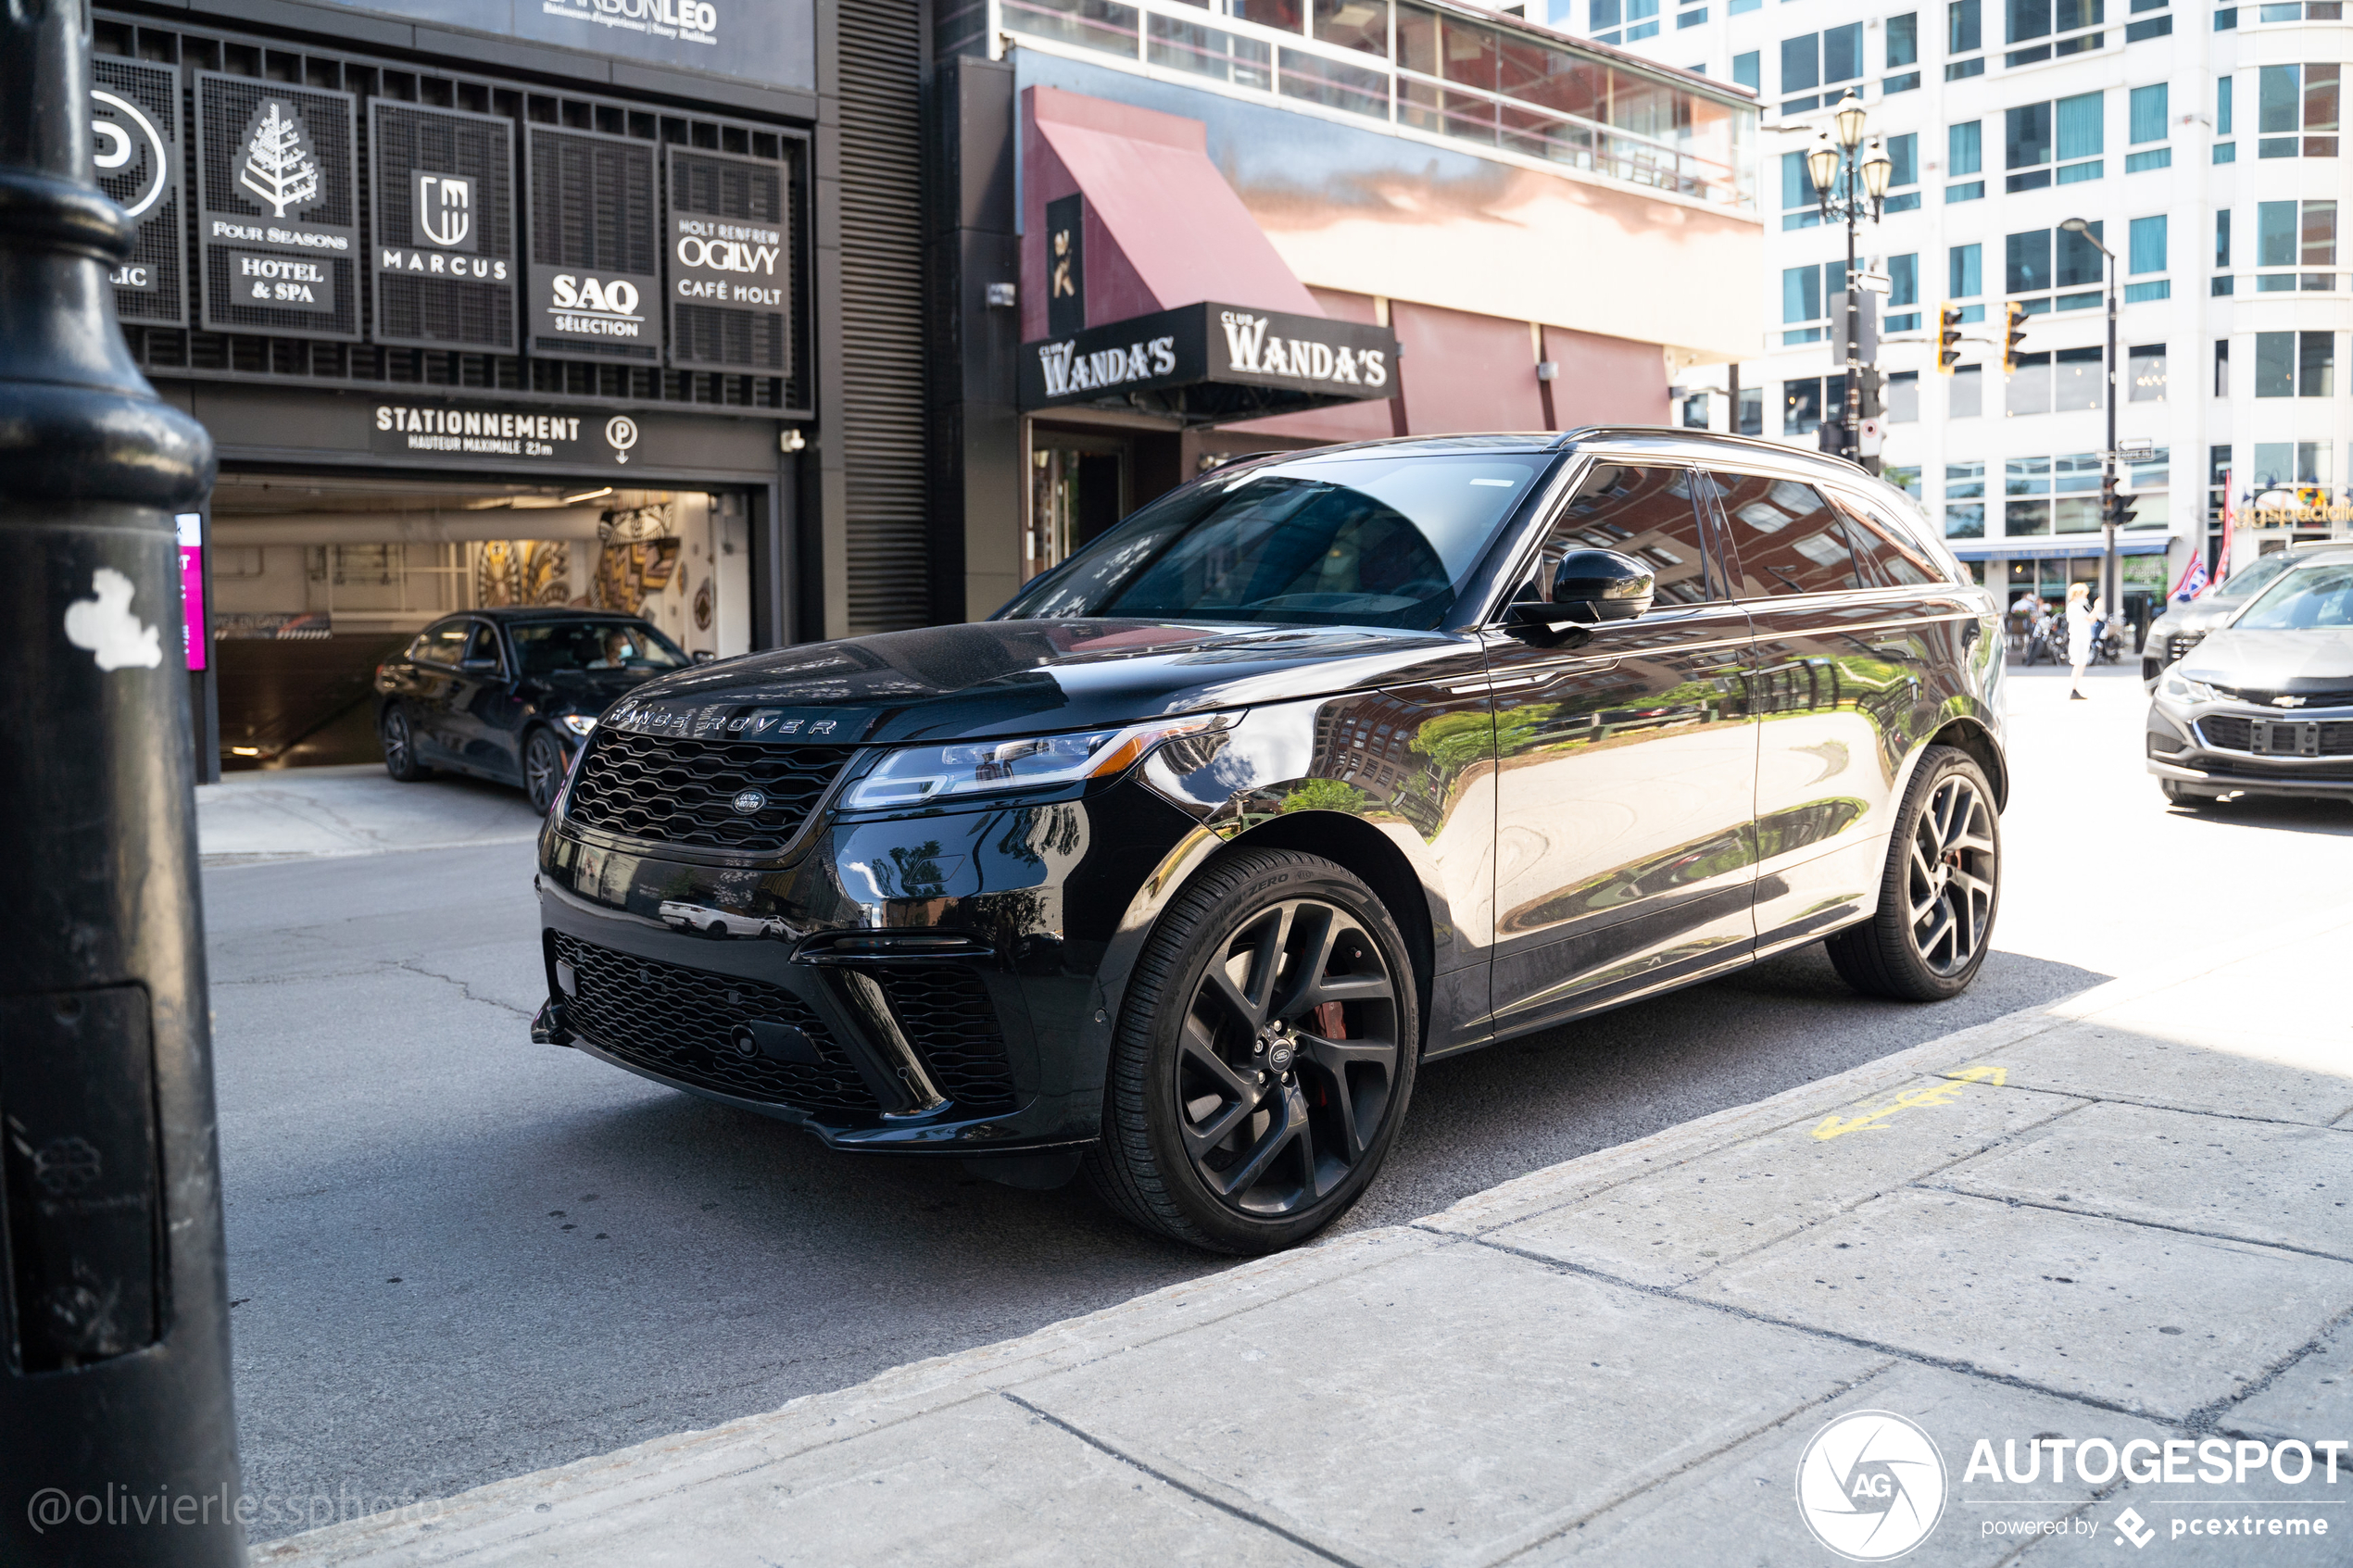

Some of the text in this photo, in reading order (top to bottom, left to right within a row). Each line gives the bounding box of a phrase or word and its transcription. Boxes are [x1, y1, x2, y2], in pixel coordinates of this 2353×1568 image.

[651, 21, 678, 41] Story
[678, 220, 780, 245] HOLT RENFREW
[383, 249, 507, 280] MARCUS
[677, 235, 781, 275] OGILVY
[241, 257, 324, 283] HOTEL
[251, 281, 315, 303] & SPA
[552, 273, 639, 315] SAQ
[677, 279, 782, 306] CAFÉ HOLT
[555, 315, 639, 337] SÉLECTION
[1220, 310, 1254, 326] CLUB
[1038, 342, 1064, 358] CLUB
[1221, 317, 1388, 388] WANDA'S
[1039, 335, 1176, 398] WANDA'S
[376, 405, 581, 442] STATIONNEMENT
[408, 434, 461, 452] HAUTEUR
[463, 437, 522, 455] MAXIMALE
[2218, 500, 2353, 529] ggspectati
[610, 701, 838, 735] RANGE ROVER
[1250, 873, 1289, 897] ZERO
